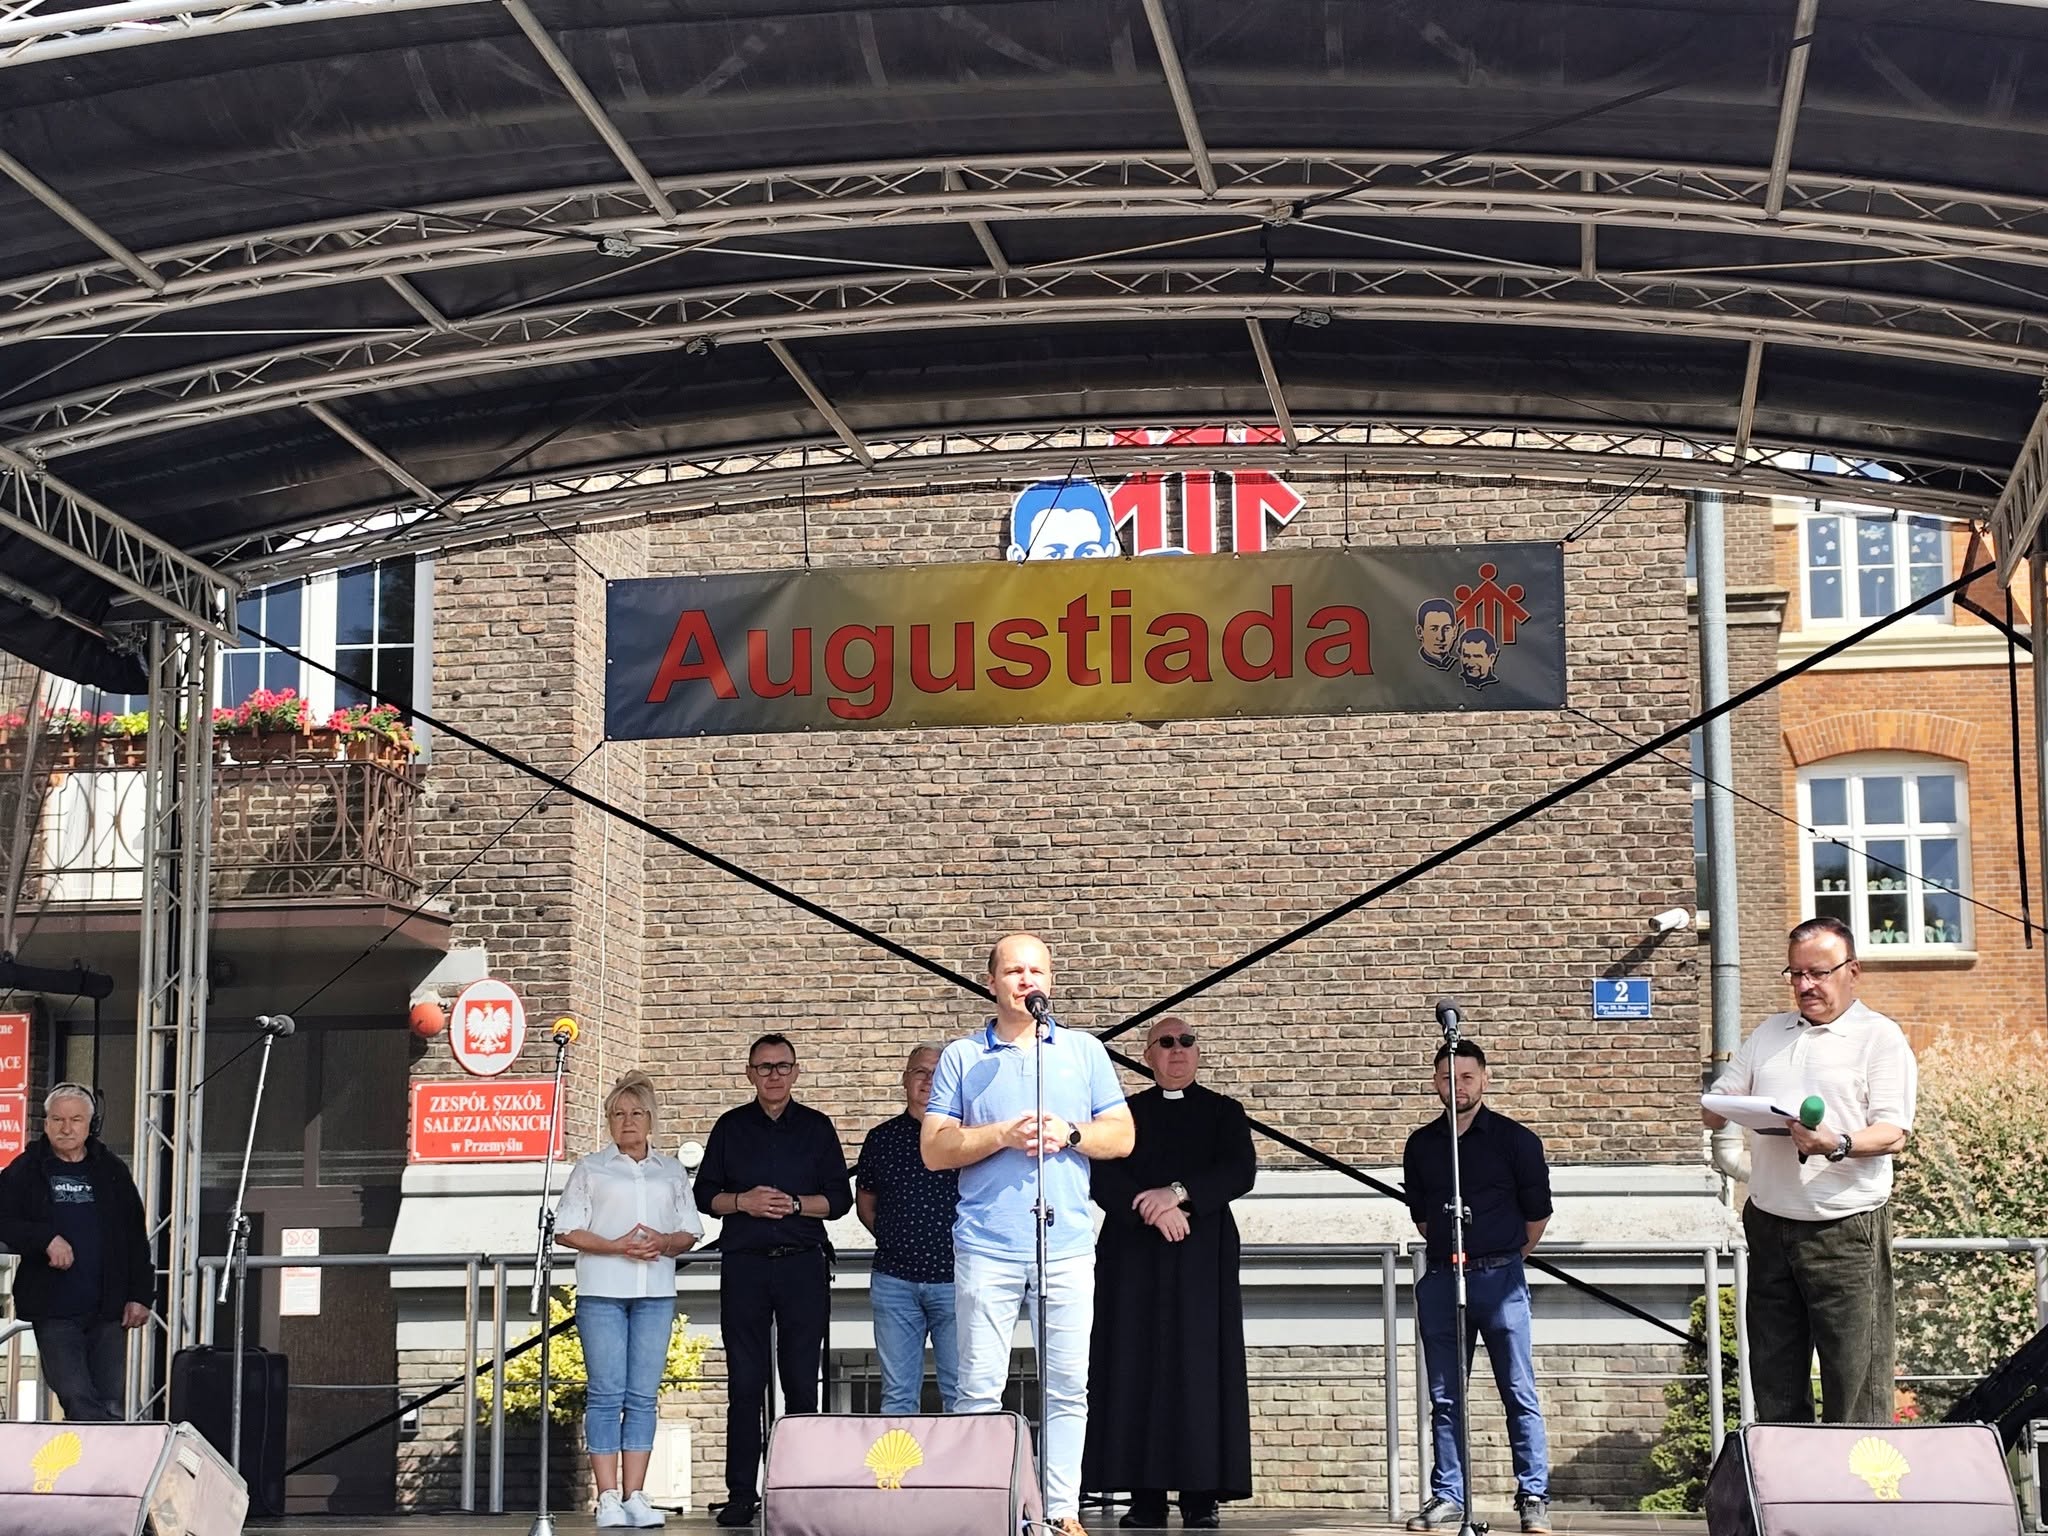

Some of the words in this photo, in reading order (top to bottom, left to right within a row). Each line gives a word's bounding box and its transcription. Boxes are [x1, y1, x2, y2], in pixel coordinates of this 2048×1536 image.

[645, 585, 1374, 720] Augustiada
[1615, 981, 1629, 1002] 2
[429, 1091, 490, 1113] ZESPÓŁ
[494, 1090, 546, 1112] SZKÓŁ
[0, 1119, 21, 1132] WA
[423, 1111, 551, 1133] SALEZJAŃSKICH
[451, 1143, 461, 1152] w
[463, 1138, 524, 1155] Przemyślu
